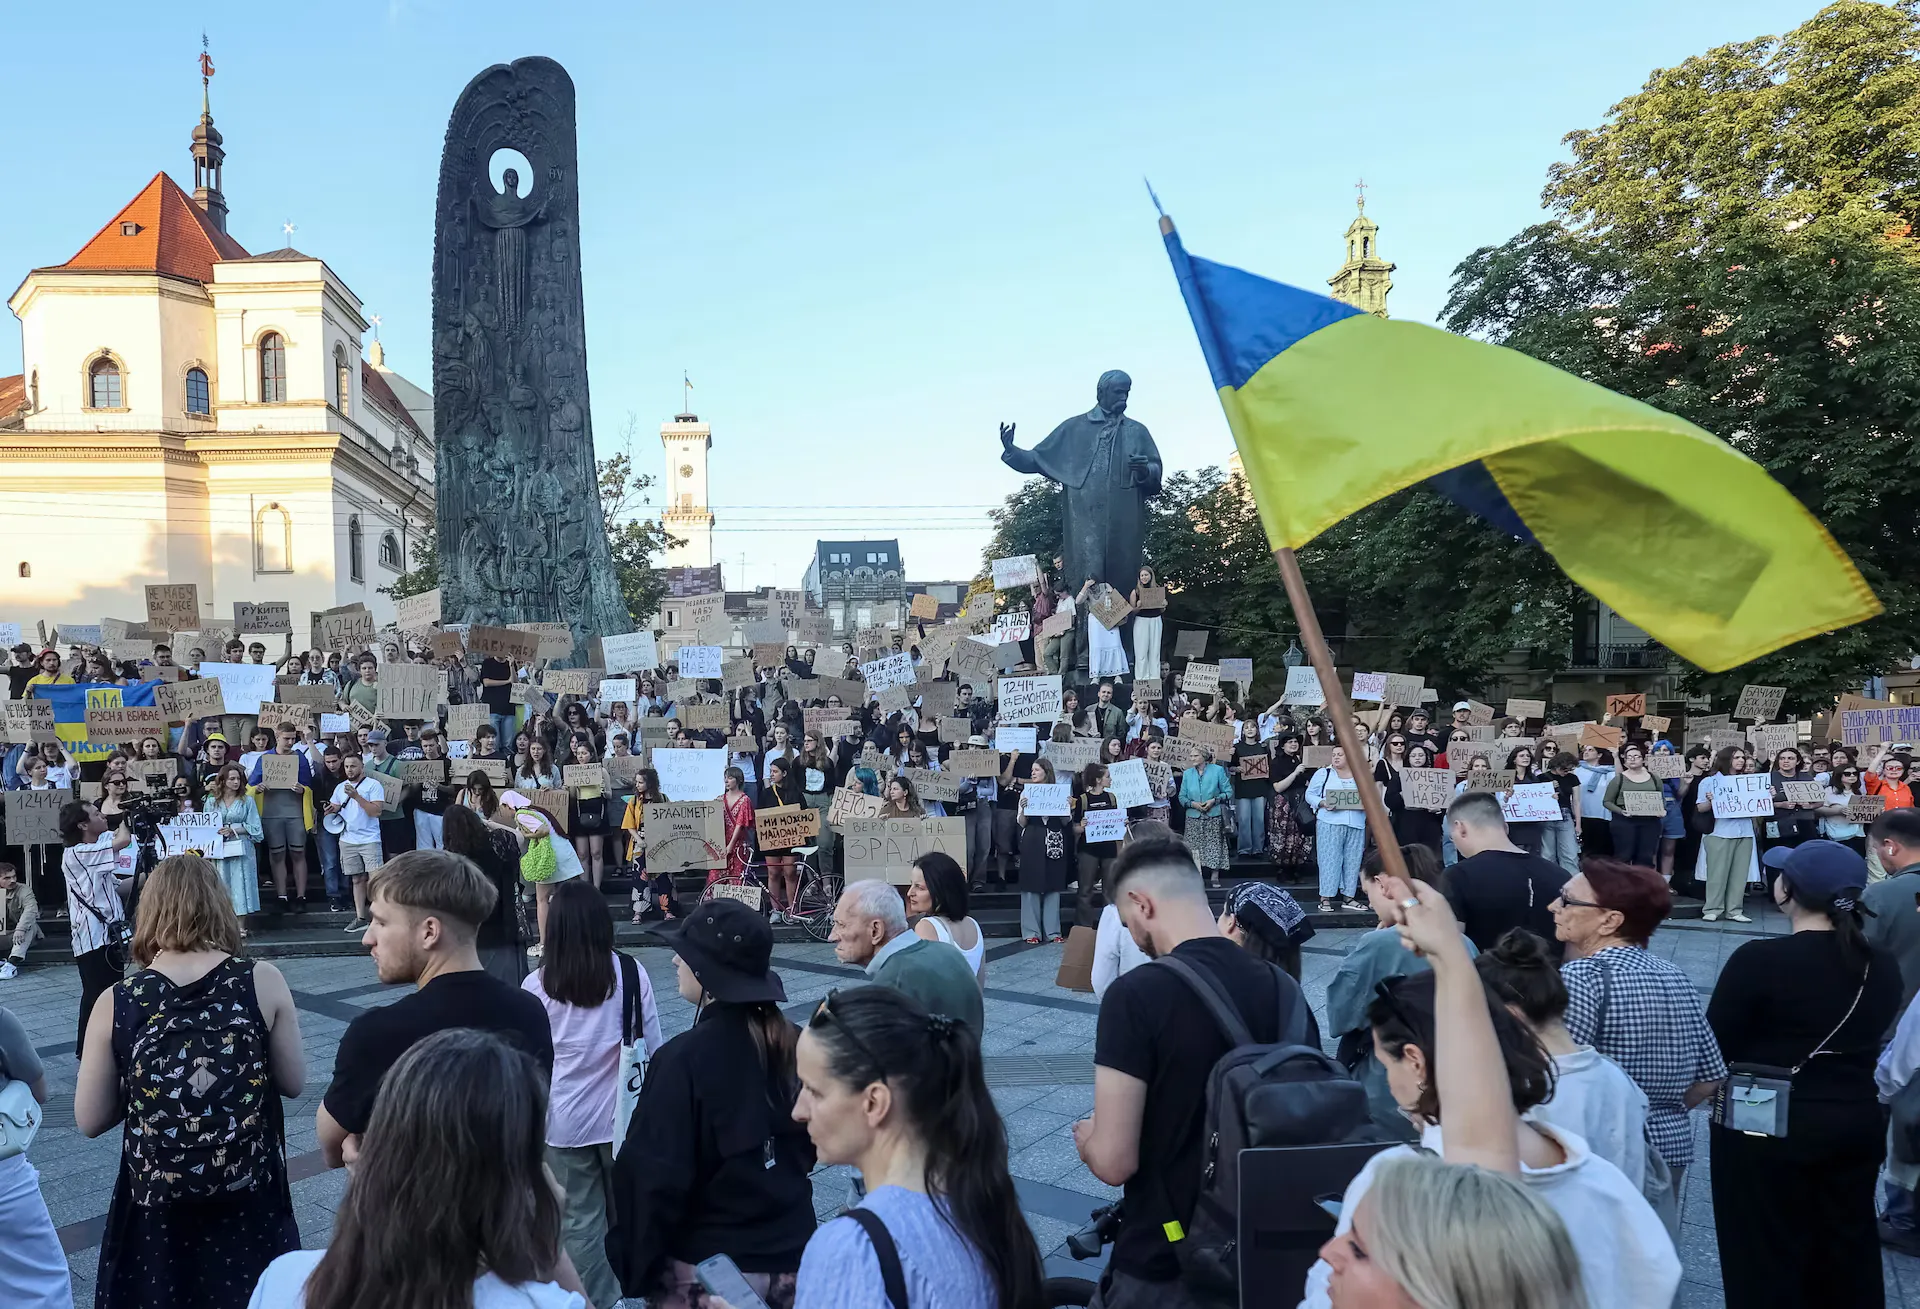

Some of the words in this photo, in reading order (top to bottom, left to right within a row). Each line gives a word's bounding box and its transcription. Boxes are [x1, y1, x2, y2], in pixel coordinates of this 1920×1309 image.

[150, 587, 158, 600] НЕ
[164, 586, 193, 600] НАБУ
[151, 601, 164, 611] ВАС
[169, 600, 192, 612] ЗНЕСЕ
[692, 606, 713, 616] НАБУ
[694, 615, 711, 624] САП
[780, 610, 794, 618] НЕ
[998, 616, 1008, 628] ЗА
[1010, 612, 1028, 626] НАБУ
[152, 616, 170, 628] ТАК
[178, 616, 197, 628] МИ
[244, 620, 268, 630] НАБУ
[324, 616, 372, 638] 12414
[780, 618, 800, 628] ОСІЯ
[330, 637, 343, 648] НЕ
[539, 635, 568, 644] ОБИВАЄ
[1296, 674, 1315, 684] 12414
[158, 686, 184, 700] Руки
[188, 684, 207, 694] геть
[206, 681, 219, 695] від
[552, 680, 584, 692] ЗРАДИ
[1003, 681, 1034, 694] 12414
[1354, 680, 1385, 693] ЗРАДА!
[1746, 686, 1783, 698] БАЧИМО
[1003, 688, 1060, 708] ДЕМОНТАЖ
[1140, 689, 1162, 697] ГАНЬБА
[1308, 689, 1324, 698] ЗРА
[162, 698, 192, 716] НАБУ
[204, 694, 218, 705] САП
[1762, 698, 1778, 707] ХТО
[262, 704, 290, 714] НАБУ
[1002, 700, 1060, 722] ДЕМОКРАТІЇ!
[90, 712, 122, 722] РУСНЯ
[127, 710, 160, 722] ВБИВАЄ
[1842, 710, 1884, 727] БУДЬ-ЯКА
[1845, 727, 1869, 745] ТЕПЕР
[1879, 726, 1894, 742] ПІД
[1898, 724, 1920, 741] ЗАГР
[62, 741, 118, 754] UKRA
[864, 754, 888, 763] 12414
[1652, 756, 1681, 766] 12414
[912, 770, 940, 783] 12414
[1405, 770, 1448, 784] ХОЧЕТЕ
[1472, 772, 1498, 780] 12414
[1418, 784, 1447, 793] РУЧНЕ
[1482, 779, 1511, 788] ЗРАДИ
[1736, 776, 1771, 792] ГЕТЬ
[1786, 782, 1820, 794] ВЕТО
[934, 785, 960, 800] ЗРАДИ
[1028, 786, 1060, 798] 12414
[1790, 794, 1802, 802] ДЕ
[1808, 792, 1826, 800] ТИ?
[16, 792, 64, 810] 12414
[1726, 794, 1739, 804] від
[1504, 804, 1523, 818] НЕ
[1716, 802, 1743, 814] НАБУ
[1747, 798, 1772, 812] САП
[1852, 805, 1877, 813] НОМЕР
[168, 812, 219, 827] МОКРАТІЯ?
[652, 807, 716, 820] ЗРАДОМЕТР
[780, 813, 814, 826] МОЖЕМО
[1850, 812, 1879, 822] ЗРАДИ
[852, 822, 944, 834] ВЕРХОВНА
[12, 829, 61, 842] ВОРО
[174, 830, 192, 843] НІ,
[760, 828, 798, 841] МАЙДАН
[160, 844, 174, 857] НЕ
[848, 836, 947, 866] ЗРАДА
